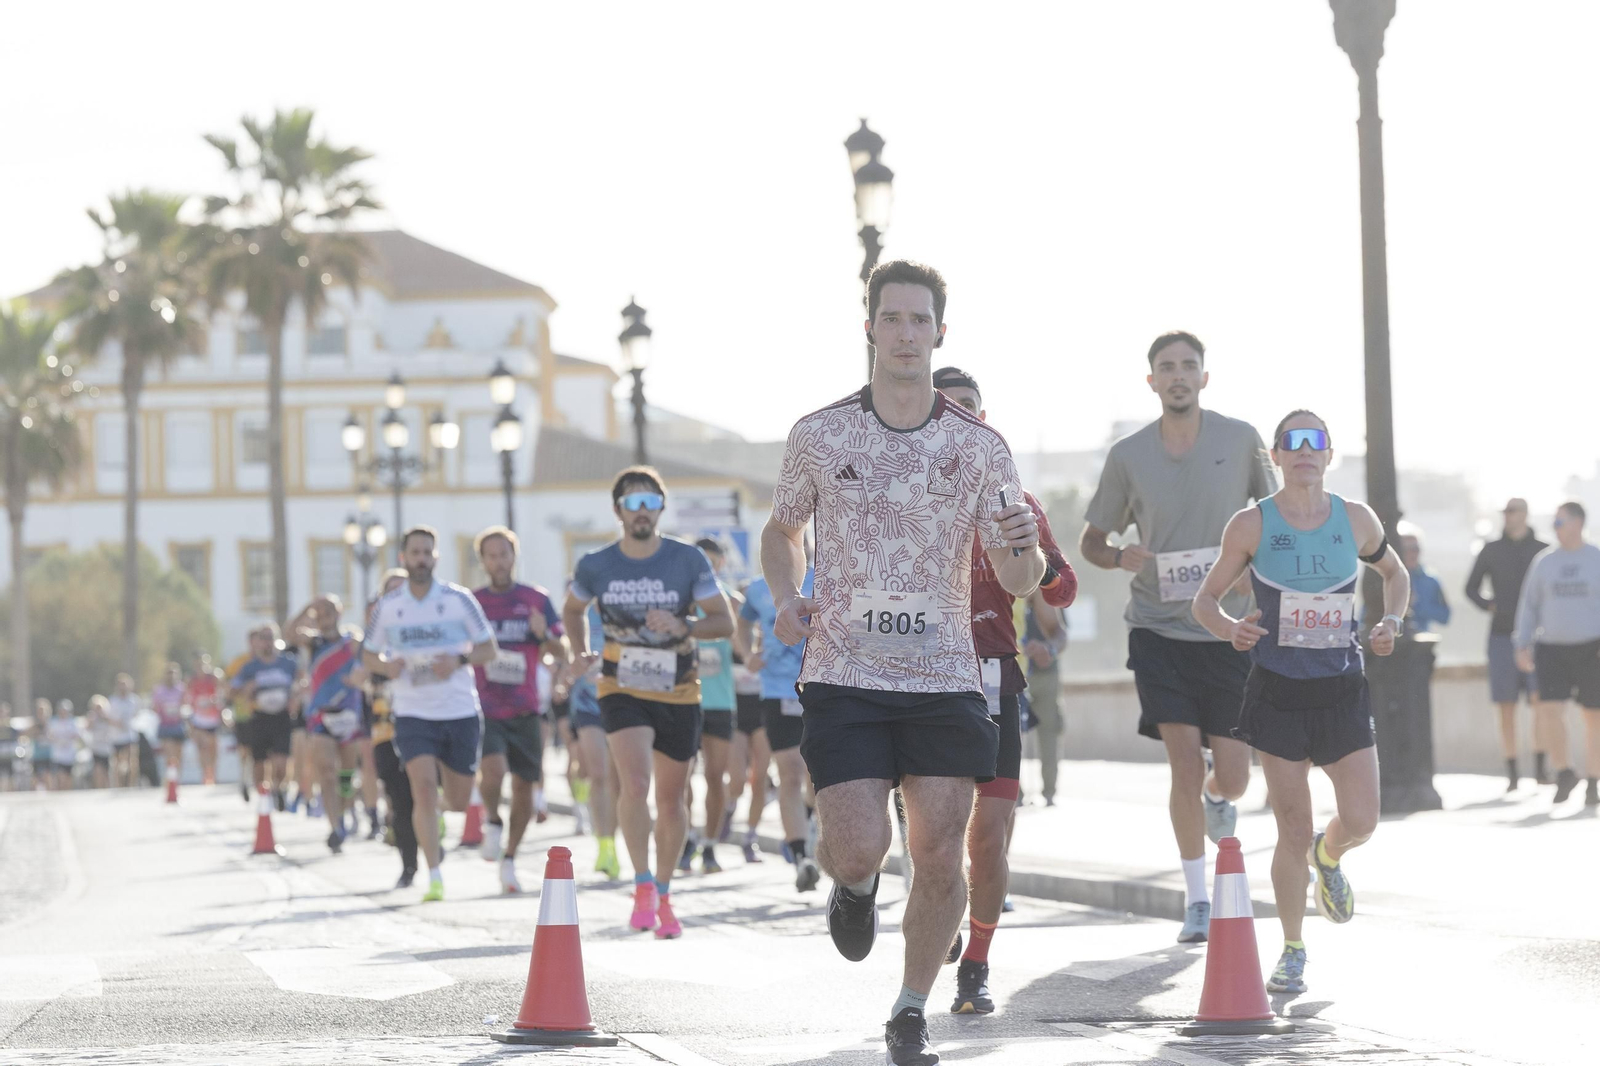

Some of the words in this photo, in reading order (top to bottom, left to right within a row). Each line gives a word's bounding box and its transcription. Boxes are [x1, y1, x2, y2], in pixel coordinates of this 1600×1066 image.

[1295, 554, 1330, 576] LR
[862, 609, 926, 635] 1805
[1291, 608, 1342, 629] 1843
